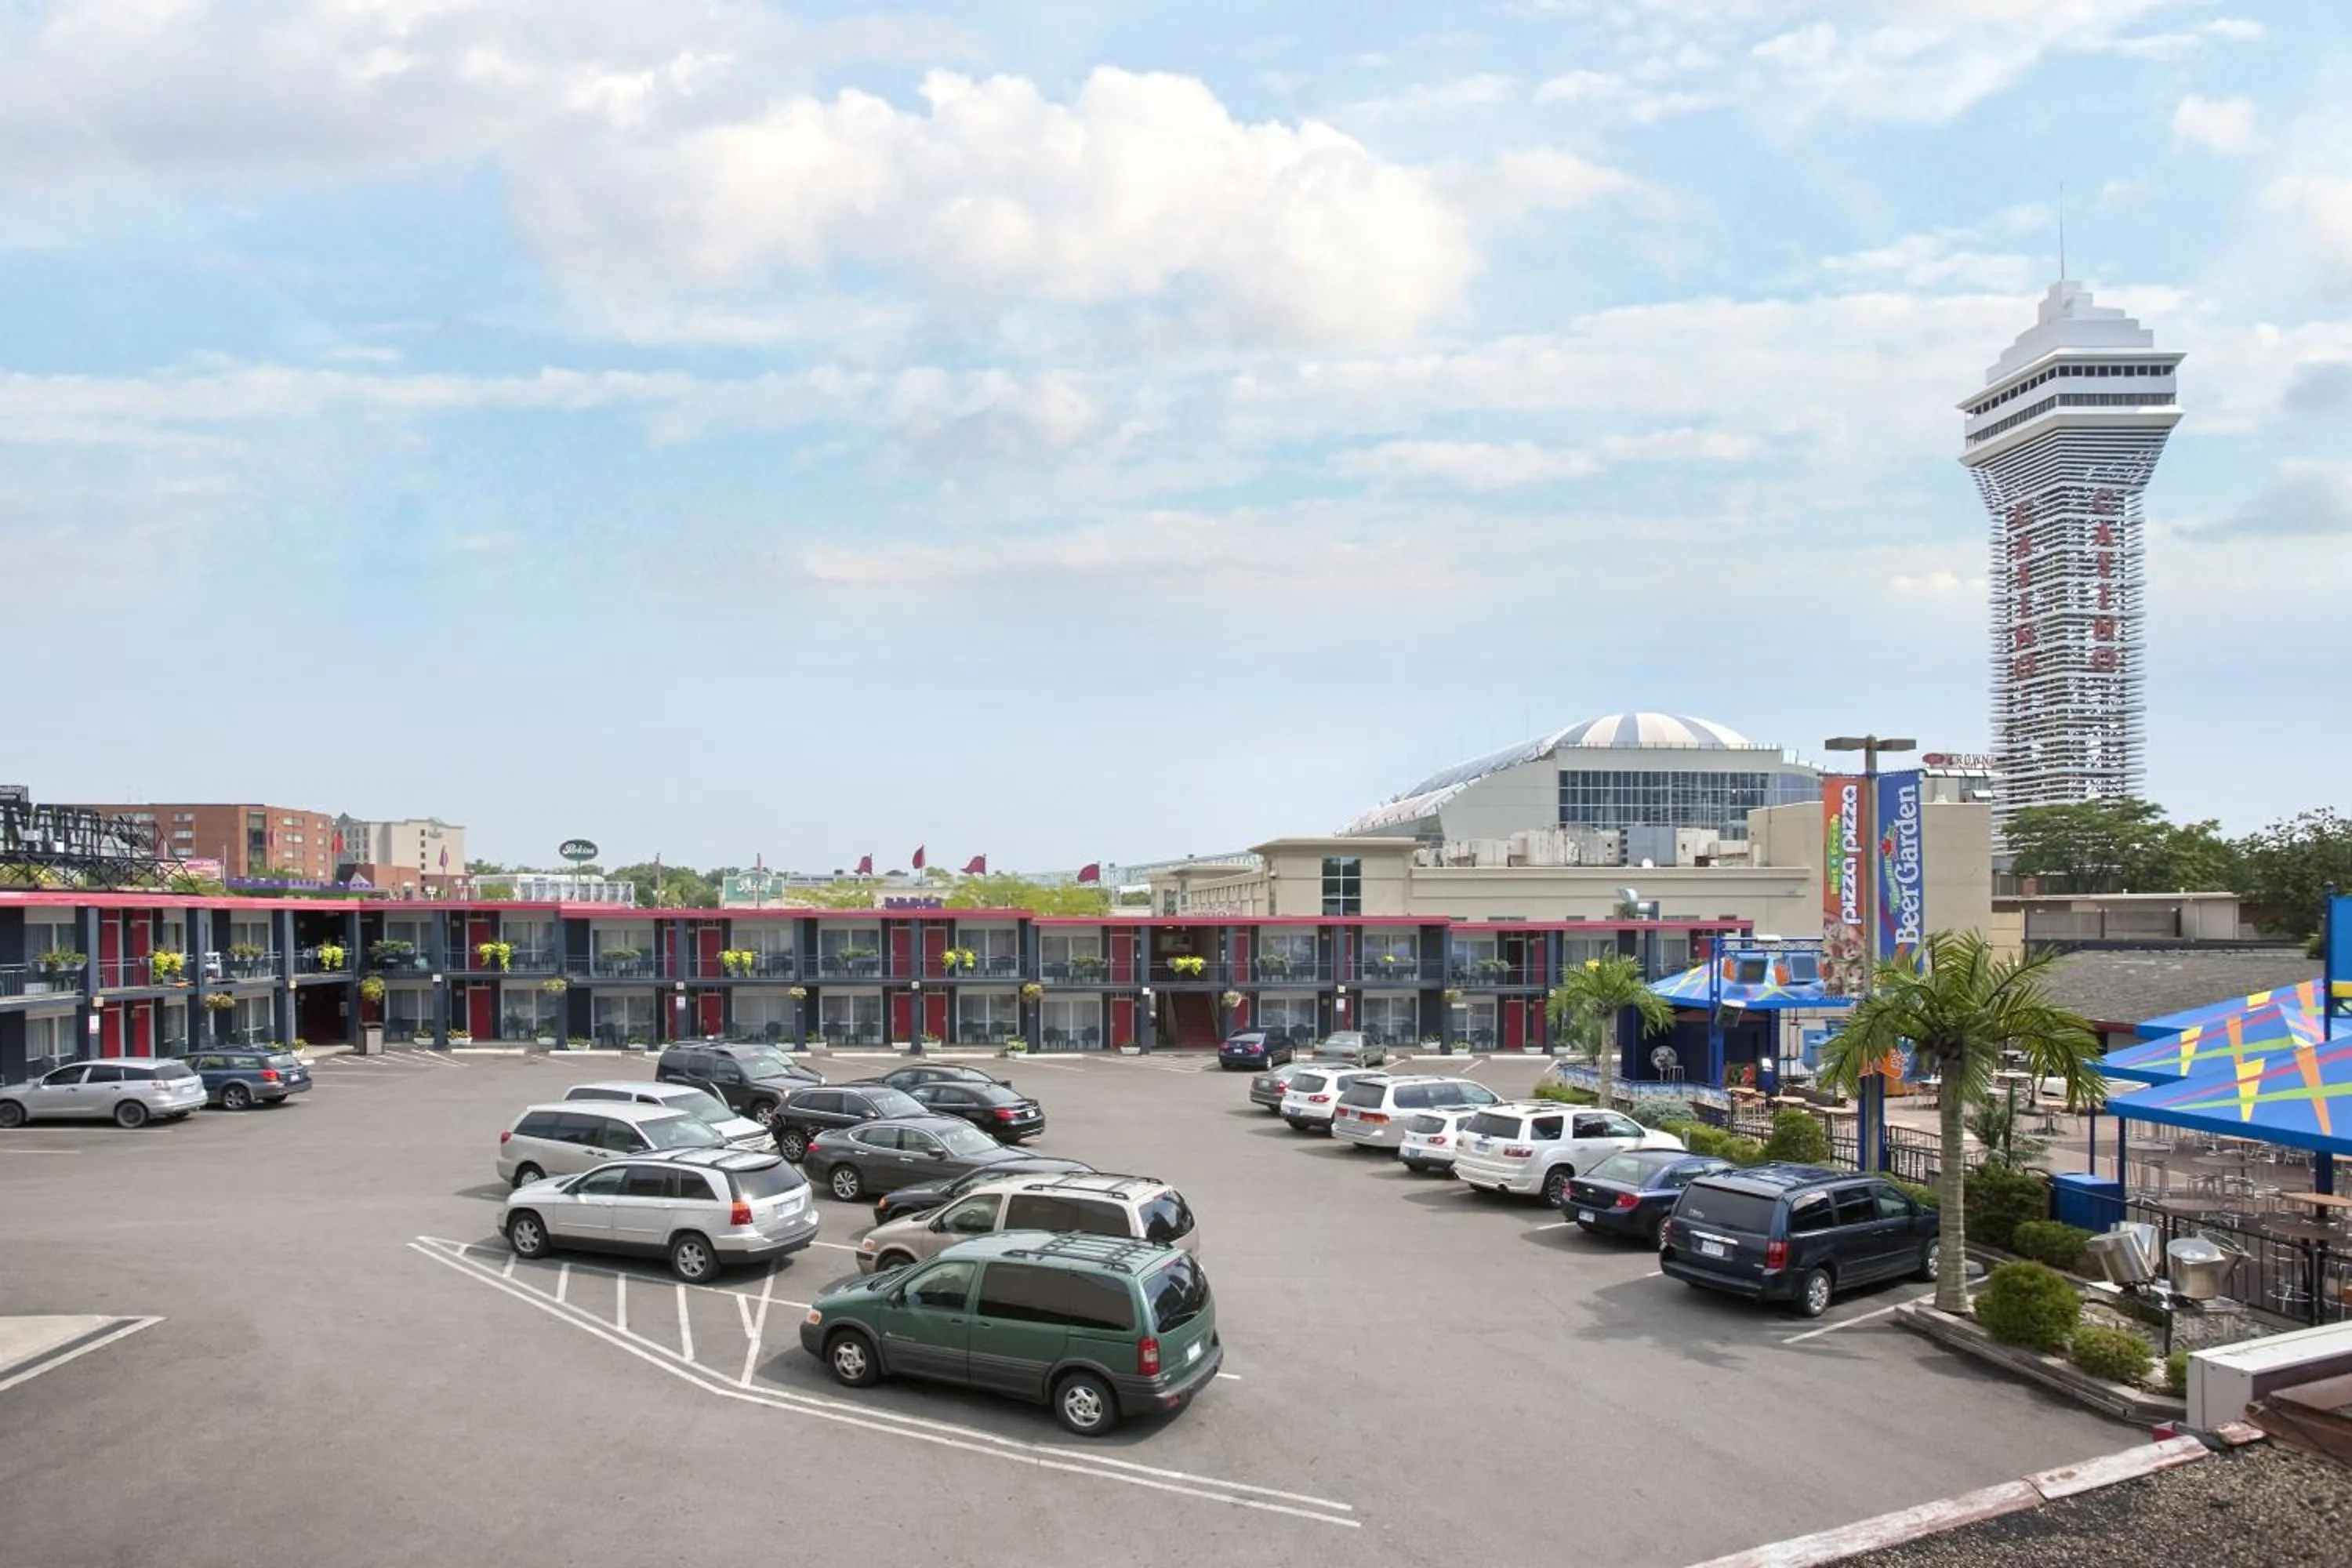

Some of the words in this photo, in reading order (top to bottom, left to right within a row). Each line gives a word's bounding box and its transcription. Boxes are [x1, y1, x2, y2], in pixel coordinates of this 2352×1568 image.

[2012, 500, 2037, 680] CASINO
[2092, 487, 2118, 672] CASINO
[1841, 785, 1862, 852] pizza
[1894, 784, 1919, 884] Garden
[1841, 857, 1862, 924] pizza
[1895, 884, 1920, 945] Beer
